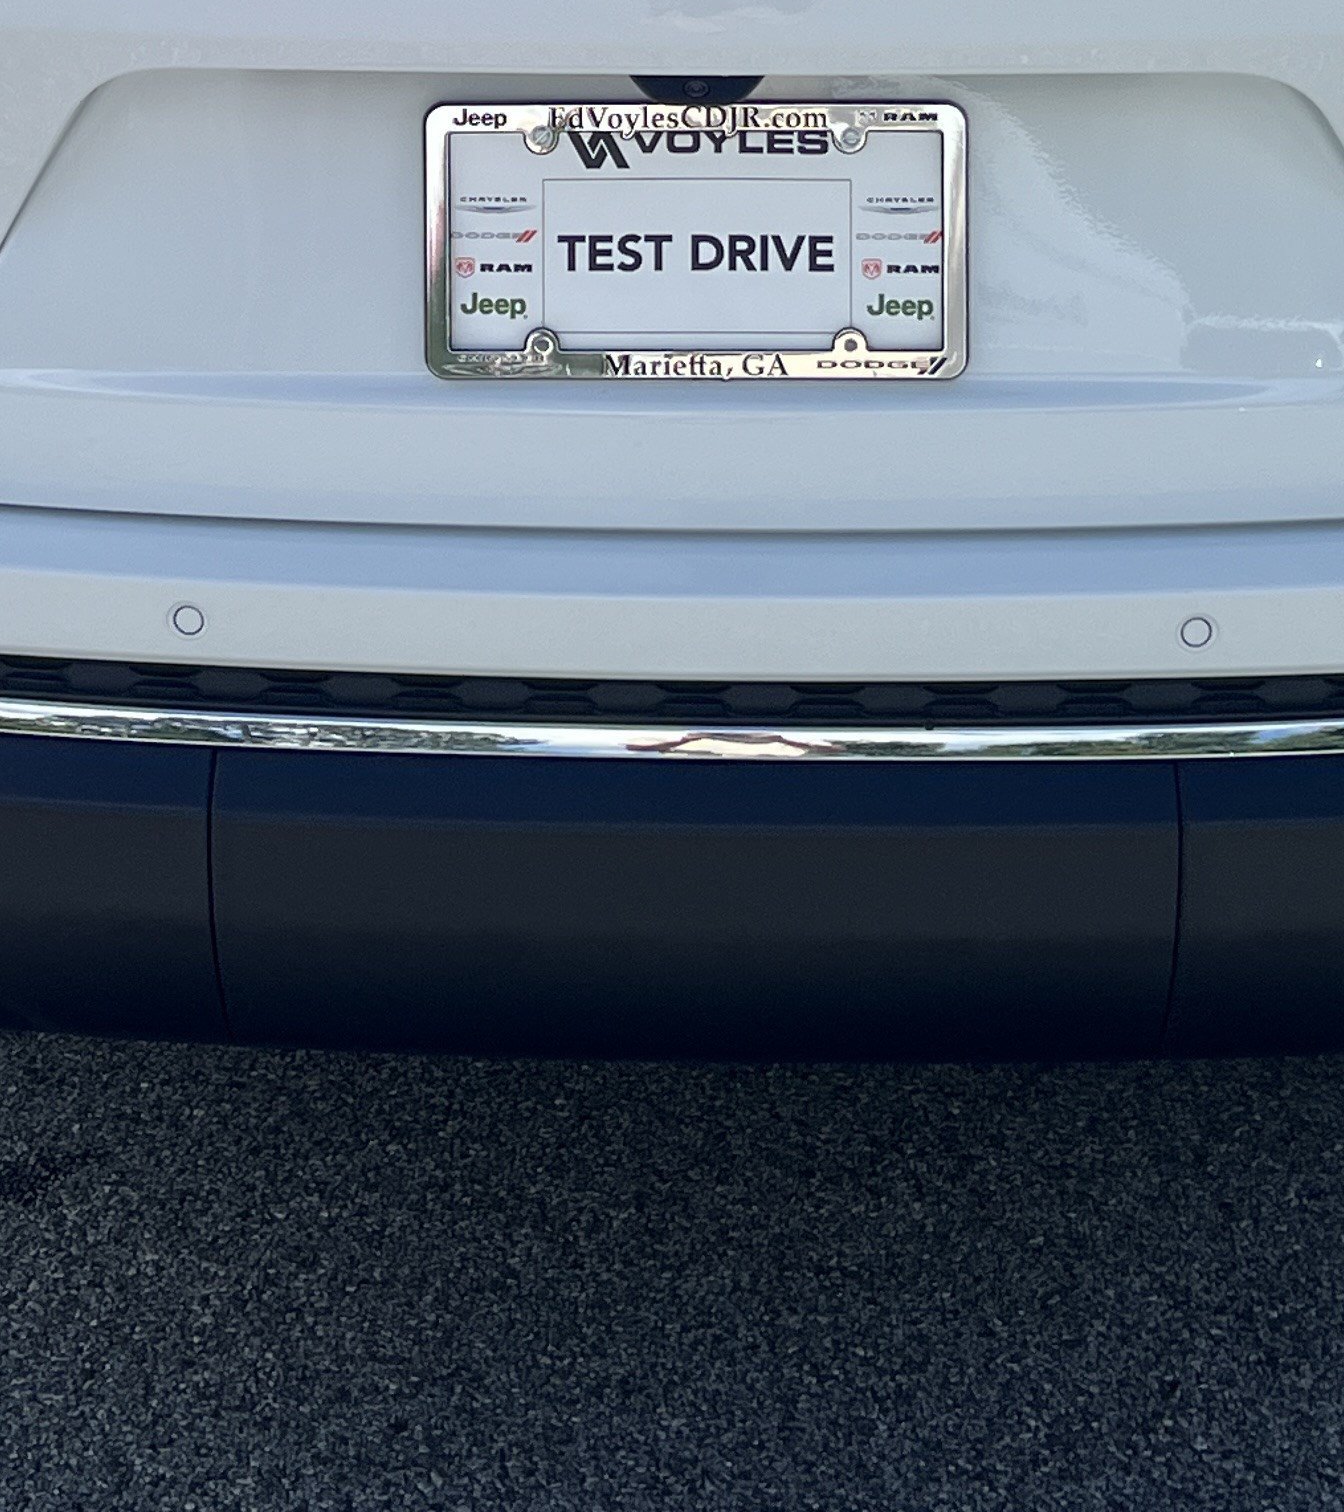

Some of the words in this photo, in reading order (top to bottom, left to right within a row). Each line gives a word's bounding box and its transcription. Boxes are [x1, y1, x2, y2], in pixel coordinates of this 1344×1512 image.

[453, 108, 508, 129] Jeep
[548, 105, 828, 139] EdVoylesCDJR.com
[883, 112, 939, 122] RAM
[633, 130, 830, 155] VOYLES
[557, 234, 673, 272] TEST
[690, 234, 836, 272] DRIVE
[479, 263, 533, 273] RAM
[886, 264, 940, 274] RAM
[460, 292, 527, 319] Jeep
[866, 293, 934, 321] Jeep
[605, 352, 734, 377] Marietta,
[741, 352, 789, 377] GA
